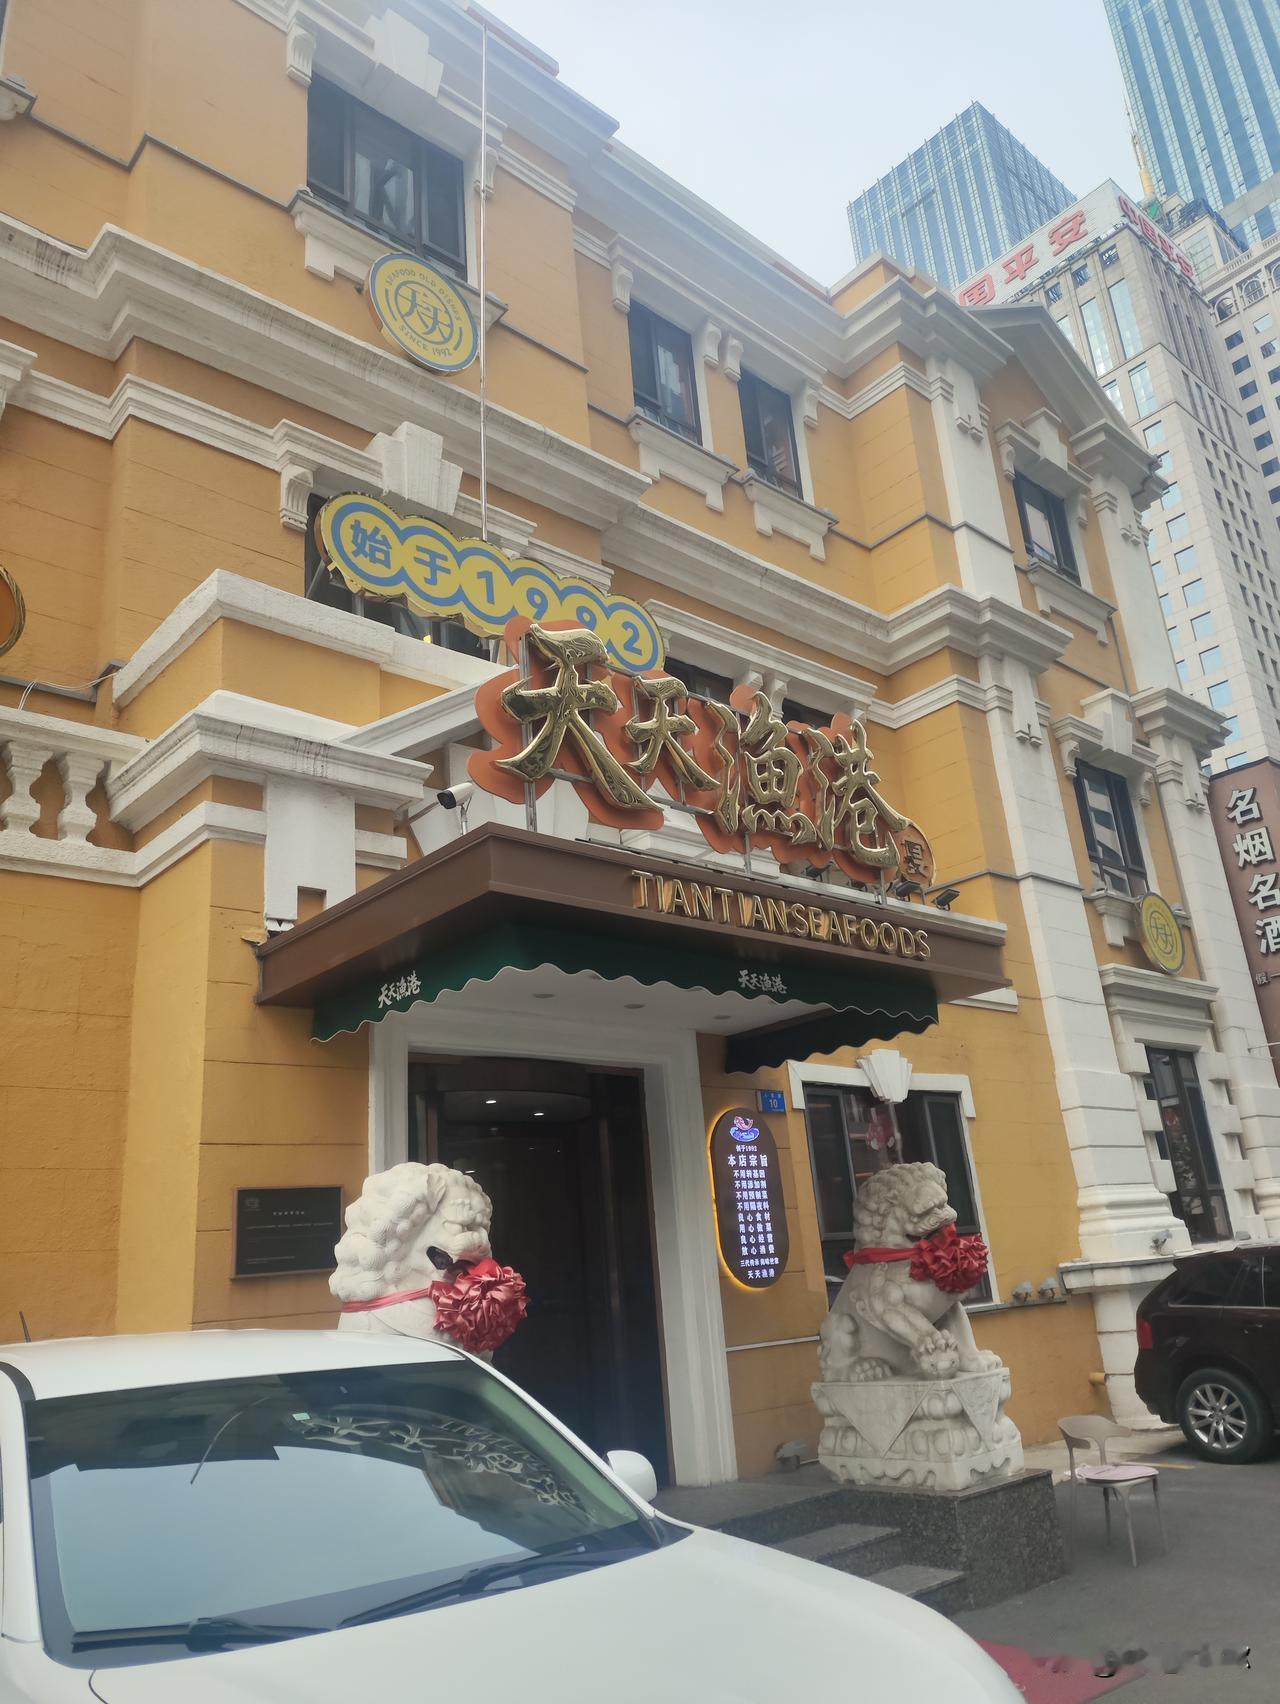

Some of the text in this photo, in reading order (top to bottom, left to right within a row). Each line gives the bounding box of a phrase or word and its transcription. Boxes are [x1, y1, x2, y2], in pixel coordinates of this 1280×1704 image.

[399, 324, 453, 357] SINCE 1992
[1226, 787, 1280, 954] 名烟名酒
[728, 1154, 767, 1167] 本店宗旨
